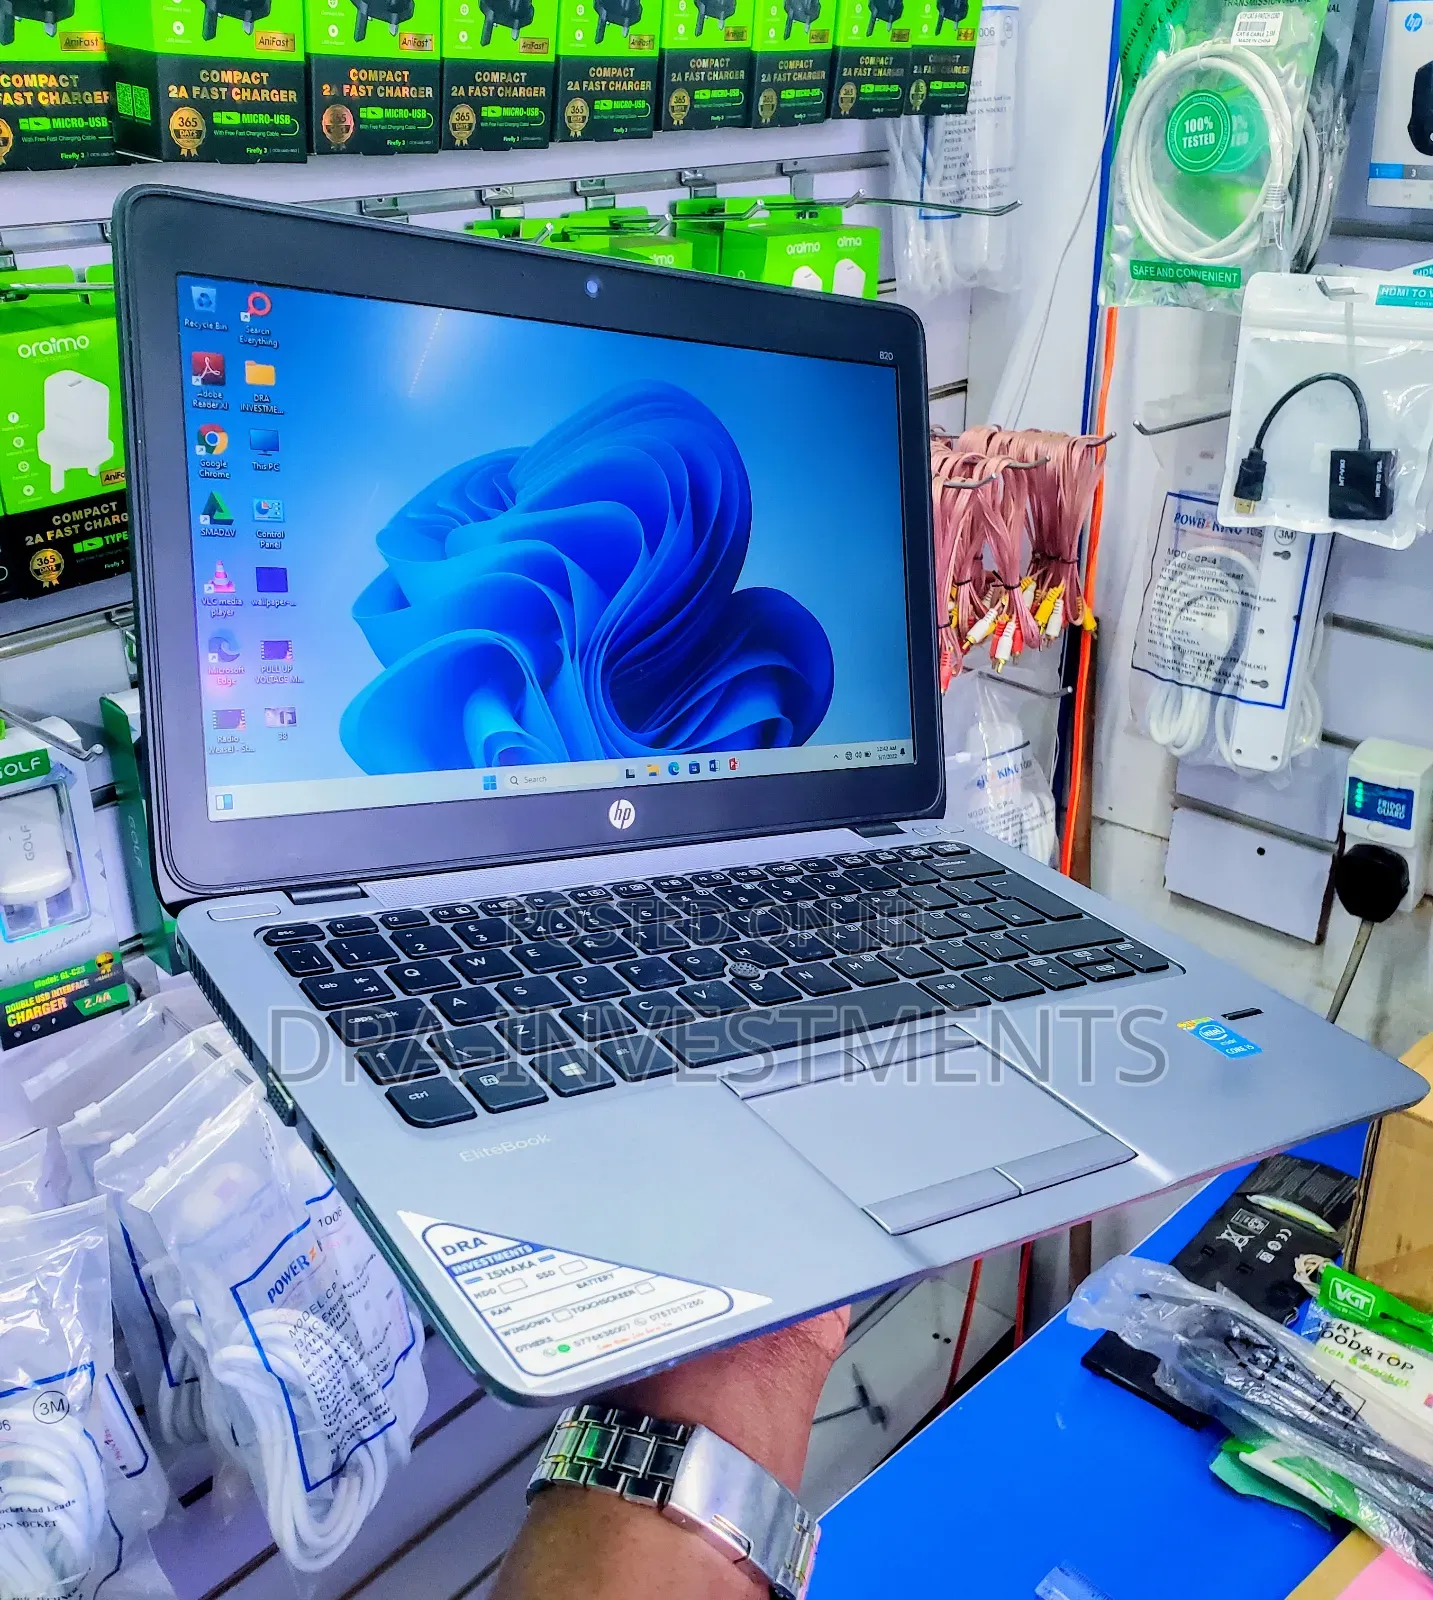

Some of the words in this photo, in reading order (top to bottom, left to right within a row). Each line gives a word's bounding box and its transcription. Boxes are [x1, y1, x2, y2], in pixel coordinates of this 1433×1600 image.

[64, 36, 100, 48] AniFast
[258, 36, 291, 48] AniFast
[690, 58, 730, 68] COMPACT
[778, 59, 813, 70] COMPACT
[199, 69, 270, 85] COMPACT
[349, 68, 410, 83] COMPACT
[475, 72, 527, 83] COMPACT
[589, 67, 635, 78] COMPACT
[671, 72, 683, 82] 2A
[684, 71, 705, 81] FAST
[707, 70, 745, 81] CHARGER
[761, 73, 771, 83] 2A
[773, 72, 792, 83] FAST
[842, 68, 852, 77] 2A
[854, 67, 872, 77] FAST
[0, 74, 79, 88] COMPACT
[567, 81, 580, 91] 2A
[582, 81, 606, 92] FAST
[608, 80, 652, 91] CHARGER
[168, 85, 188, 99] 2A
[192, 86, 227, 101] FAST
[231, 89, 298, 103] CHARGER
[343, 84, 373, 97] FAST
[377, 85, 433, 98] CHARGER
[451, 86, 465, 97] 2A
[468, 86, 496, 97] FAST
[497, 86, 546, 97] CHARGER
[613, 99, 646, 109] MICRO-USB
[674, 95, 686, 104] 365
[384, 108, 427, 120] MICRO-USB
[503, 106, 539, 118] MICRO-USB
[570, 105, 584, 115] 365
[52, 116, 108, 129] MICRO-USB
[178, 116, 198, 128] 365
[241, 113, 291, 125] MICRO-USB
[455, 112, 470, 122] 365
[1183, 116, 1213, 133] 100%
[1182, 132, 1215, 149] TESTED
[786, 241, 821, 255] oraimo
[1132, 264, 1155, 276] SAFE
[1156, 267, 1174, 278] AND
[1175, 268, 1238, 283] CONVENIENT
[1381, 286, 1409, 297] HDMI
[1412, 289, 1427, 298] TO
[184, 318, 213, 330] Recycle
[215, 322, 228, 330] Bin
[246, 325, 270, 335] Search
[17, 335, 90, 359] oraimo
[239, 335, 278, 348] Everything
[253, 393, 270, 402] DRA
[193, 399, 218, 409] Reader
[201, 459, 227, 469] Google
[252, 461, 267, 470] This
[199, 469, 230, 479] Chrome
[52, 501, 118, 526] COMPACT
[25, 533, 44, 546] 2A
[46, 524, 80, 541] FAST
[256, 530, 284, 539] Control
[260, 541, 281, 549] Panel
[36, 554, 56, 567] 365
[201, 598, 217, 606] VLC
[219, 598, 243, 606] media
[211, 609, 235, 618] player
[208, 665, 245, 675] Microsoft
[282, 665, 293, 674] UP
[217, 677, 237, 687] Edge
[217, 735, 238, 744] Radio
[524, 774, 547, 784] Search
[1377, 798, 1406, 815] FRIDGE
[608, 799, 636, 830] hp
[1377, 806, 1406, 820] GUARD
[20, 824, 35, 861] GOLF
[34, 974, 60, 990] Model:
[318, 981, 338, 990] tab
[5, 996, 35, 1015] DOUBLE
[35, 991, 51, 1005] USB
[51, 978, 90, 998] INTERFACE
[84, 991, 112, 1009] 2.4A
[7, 996, 68, 1028] CHARGER
[348, 1013, 374, 1025] caps
[375, 1009, 400, 1020] lock
[1225, 1046, 1244, 1055] CORE
[408, 1090, 429, 1100] ctrl
[459, 1134, 552, 1163] EliteBook
[440, 1236, 488, 1256] DRA
[451, 1244, 534, 1275] INVESTMENTS
[486, 1260, 538, 1281] ISHAKA
[267, 1254, 310, 1304] POWER
[474, 1288, 497, 1300] HDD
[536, 1269, 556, 1280] SSD
[490, 1305, 512, 1317] RAM
[576, 1272, 615, 1290] BATTERY
[1335, 1282, 1371, 1310] VGT
[501, 1316, 552, 1337] WINDOWS
[571, 1289, 636, 1315] TOUCHSCREEN
[40, 1399, 65, 1415] 3M
